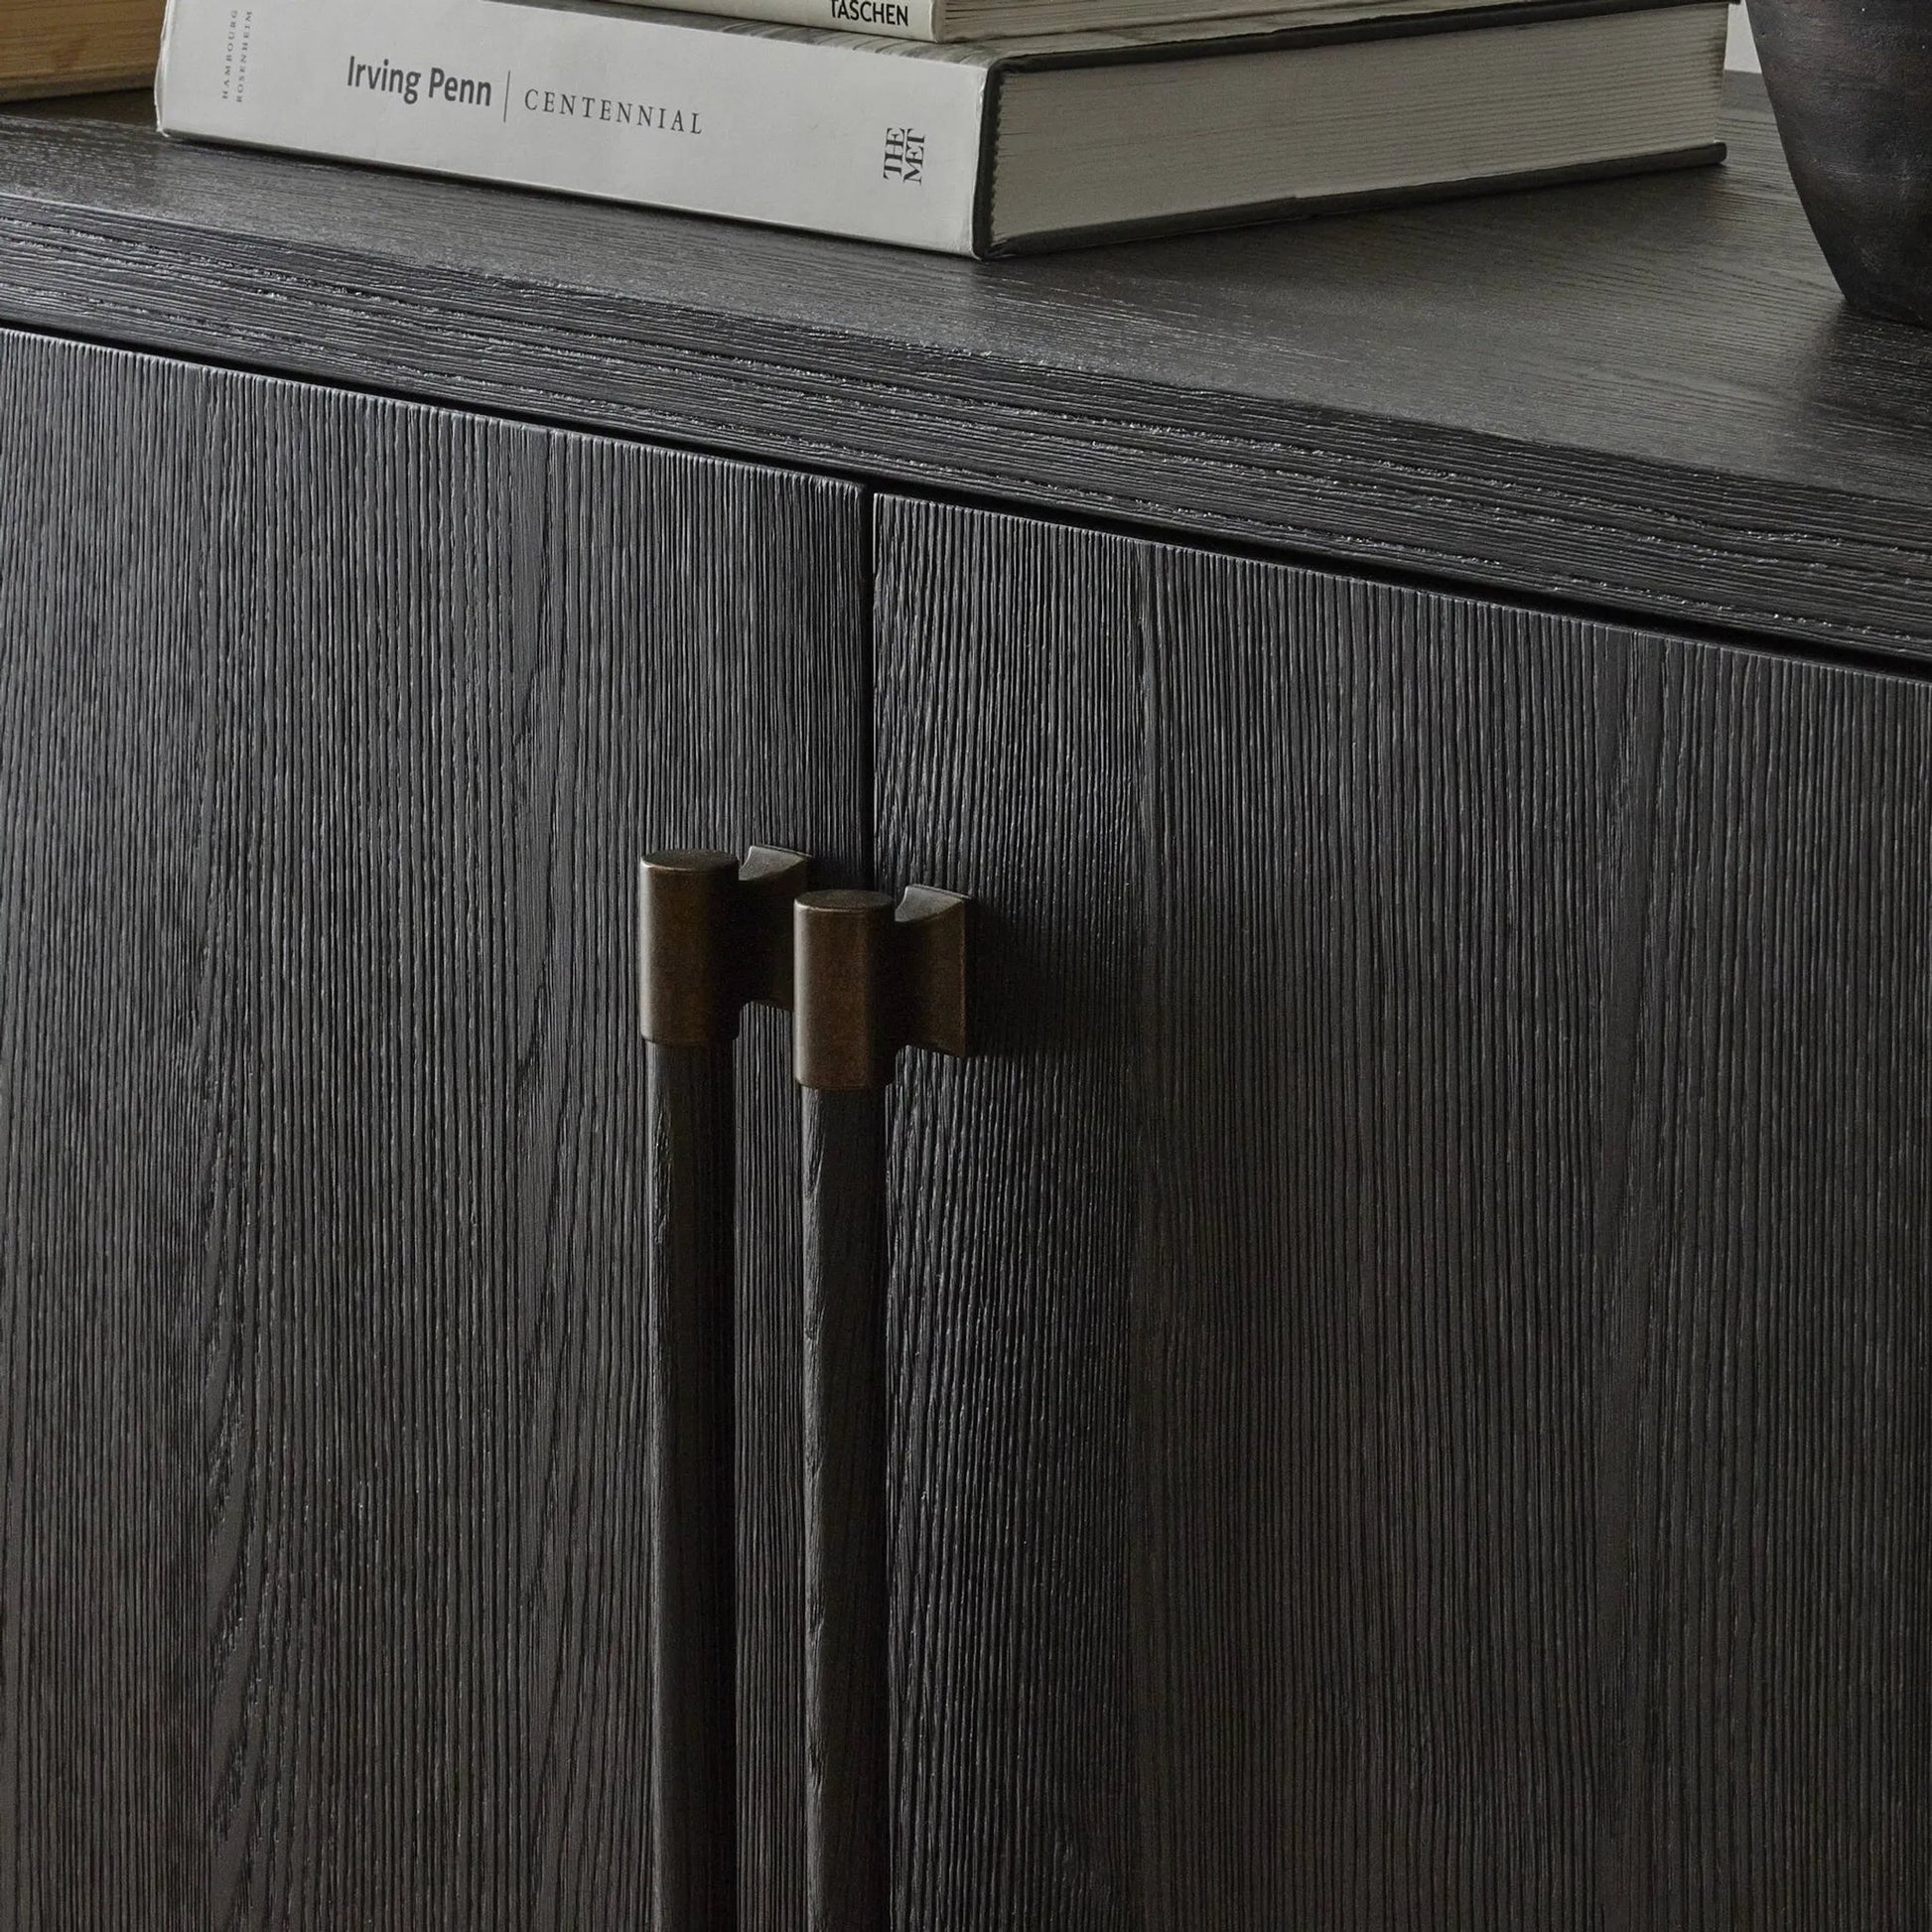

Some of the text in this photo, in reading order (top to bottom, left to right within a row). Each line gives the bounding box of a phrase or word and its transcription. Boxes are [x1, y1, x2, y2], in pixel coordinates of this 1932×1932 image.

[830, 0, 908, 27] TASCHEN
[221, 10, 237, 99] HAMBOURG
[236, 11, 252, 102] ROSENHEIM
[346, 56, 703, 134] Irving Penn CENTENNIAL
[883, 127, 905, 180] THE
[902, 128, 925, 186] MET
